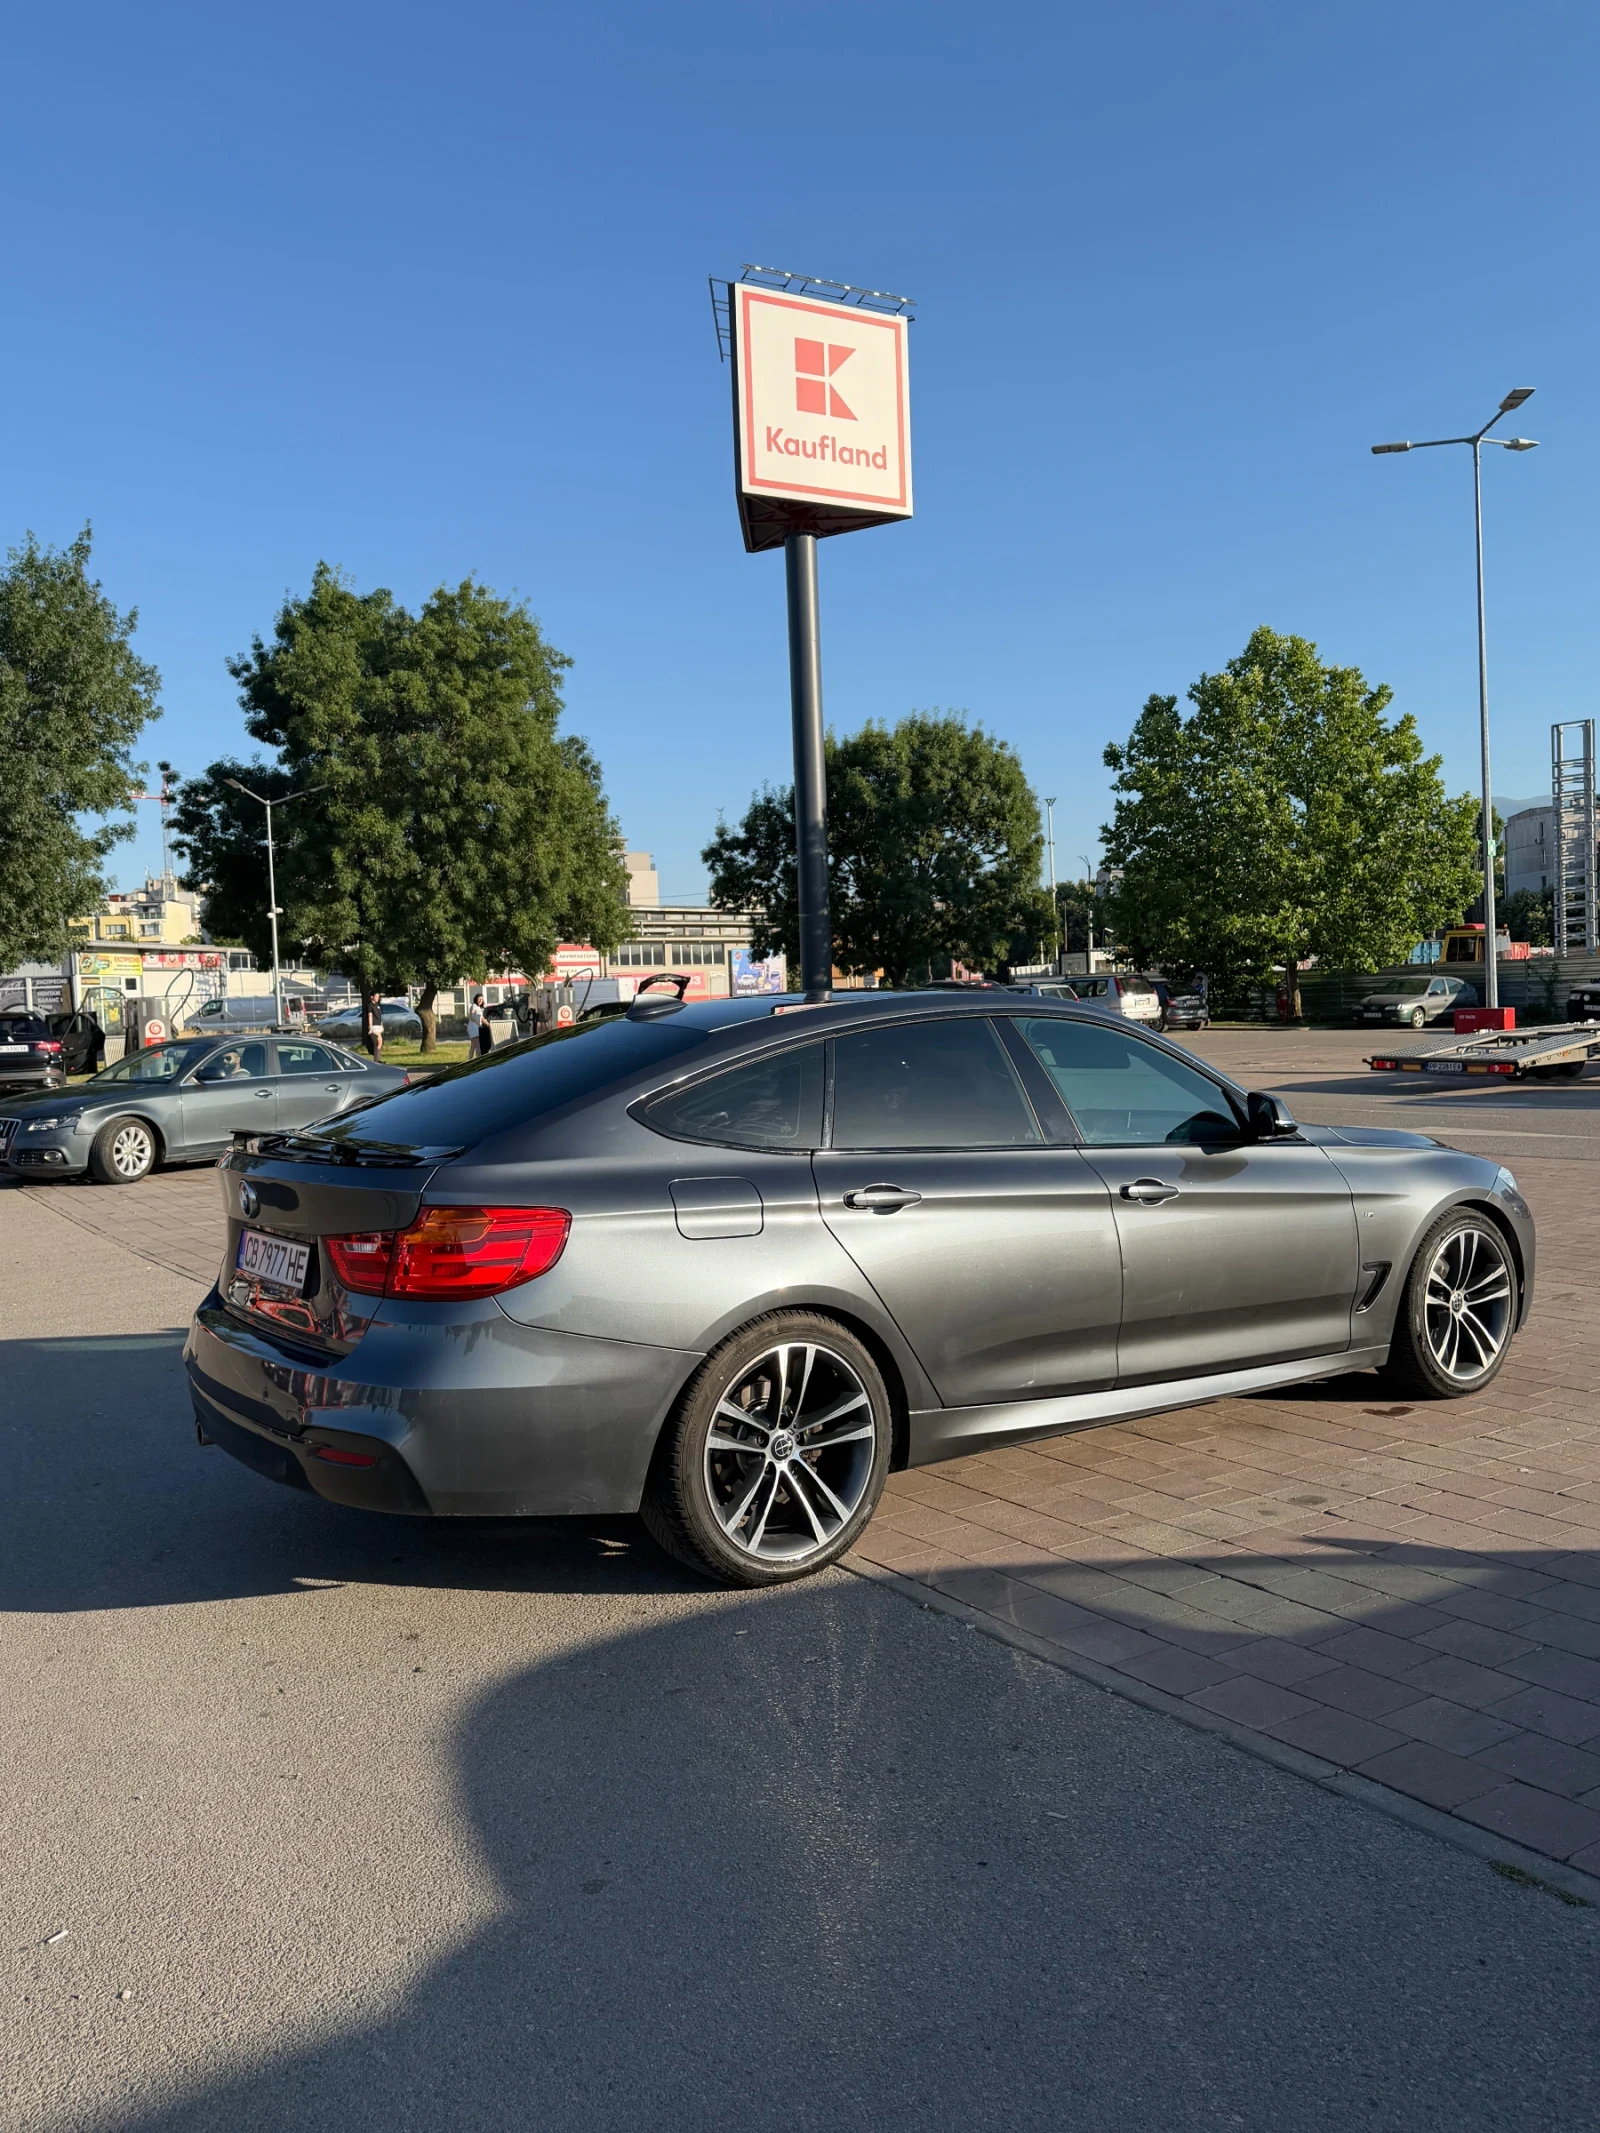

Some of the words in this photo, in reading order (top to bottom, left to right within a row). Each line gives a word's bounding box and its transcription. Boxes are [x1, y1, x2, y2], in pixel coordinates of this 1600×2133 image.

[766, 426, 887, 470] Kaufland
[258, 1240, 287, 1277] 7977
[285, 1247, 307, 1284] HE
